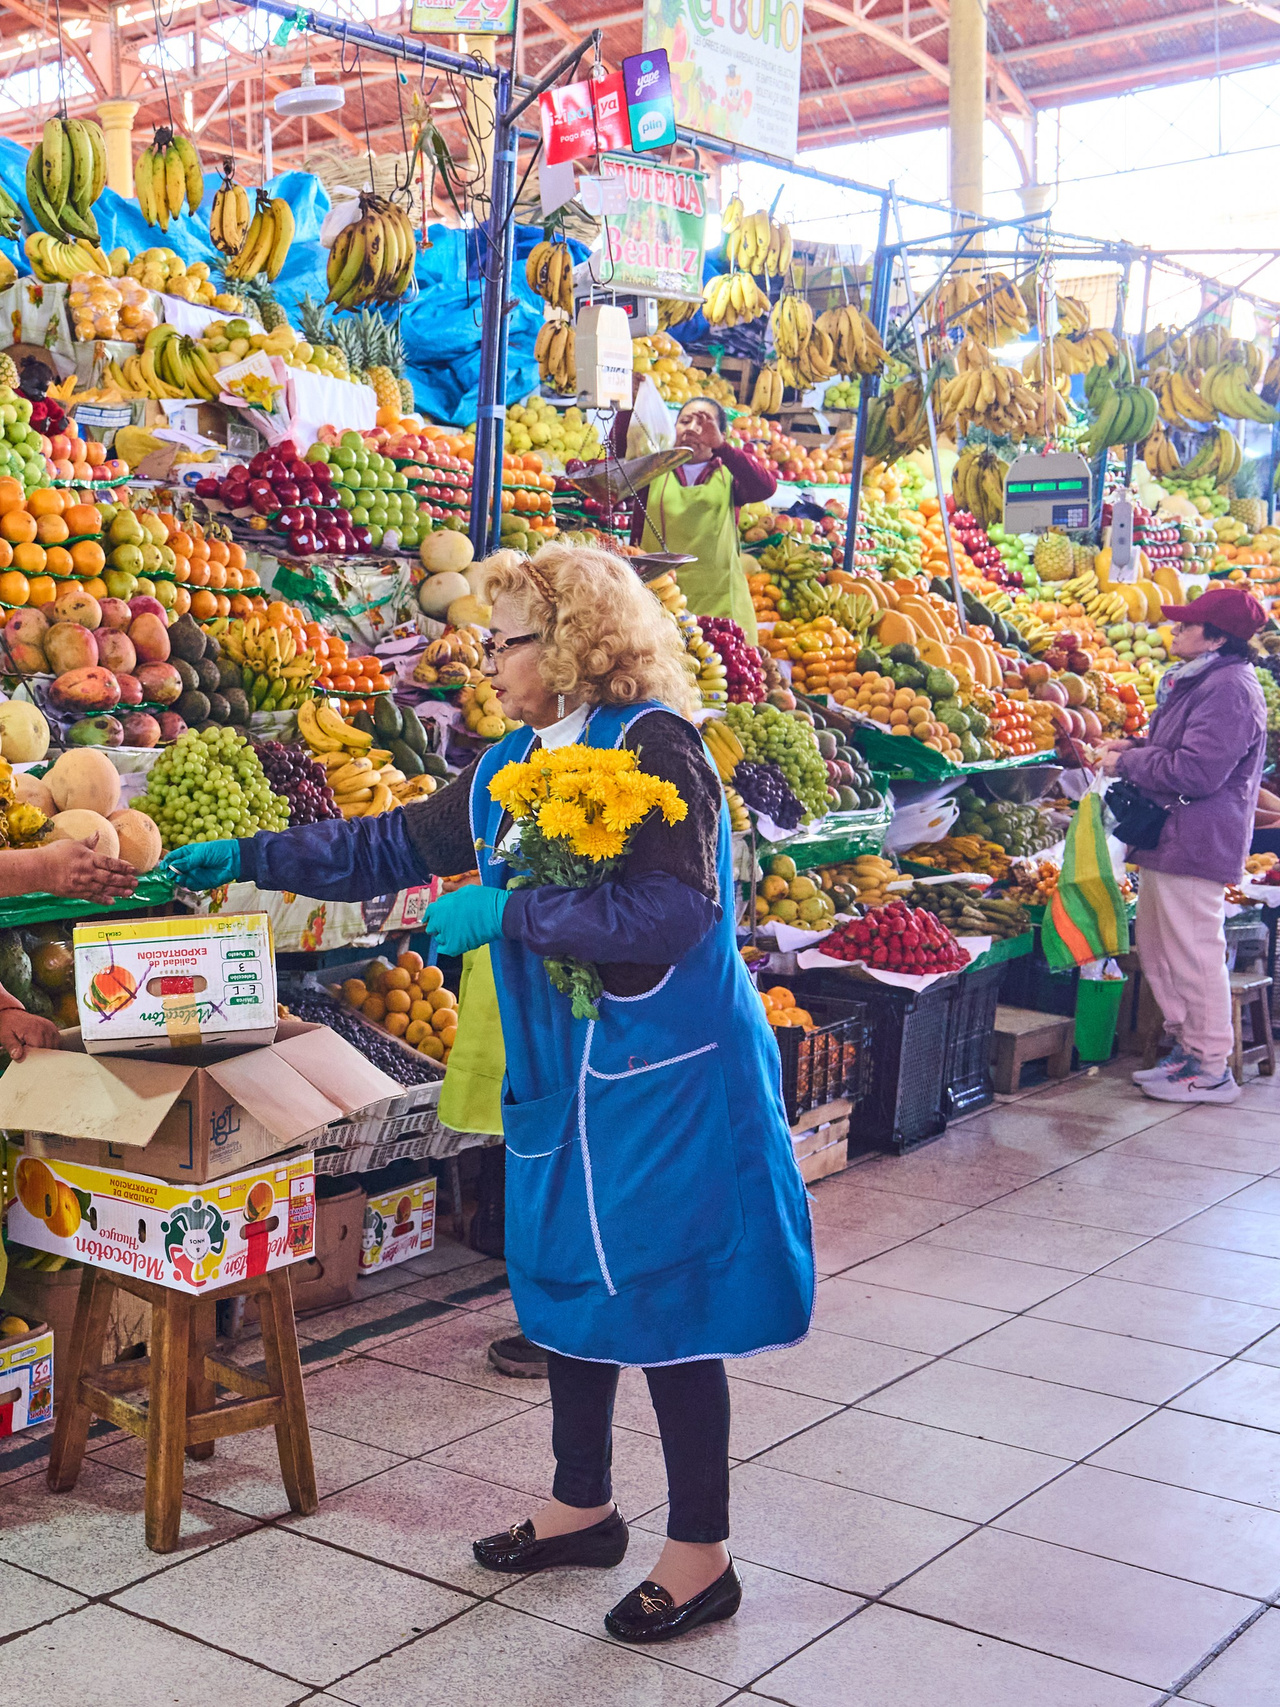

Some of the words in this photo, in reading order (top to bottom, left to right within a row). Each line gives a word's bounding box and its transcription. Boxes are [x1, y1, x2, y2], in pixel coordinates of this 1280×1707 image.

[729, 0, 800, 53] BUHO
[635, 70, 660, 97] yape
[600, 99, 617, 115] ya
[642, 120, 663, 134] plin
[560, 131, 579, 143] Paga
[604, 225, 699, 275] Beatriz
[137, 947, 208, 961] EXPORTACIÓN
[149, 959, 160, 968] de
[163, 958, 198, 967] Calidad
[238, 962, 246, 973] 3
[113, 1188, 122, 1196] DE
[299, 1182, 305, 1192] 3
[124, 1192, 155, 1204] CALIDAD
[99, 1228, 139, 1251] Huayco
[73, 1236, 164, 1281] Melocotón
